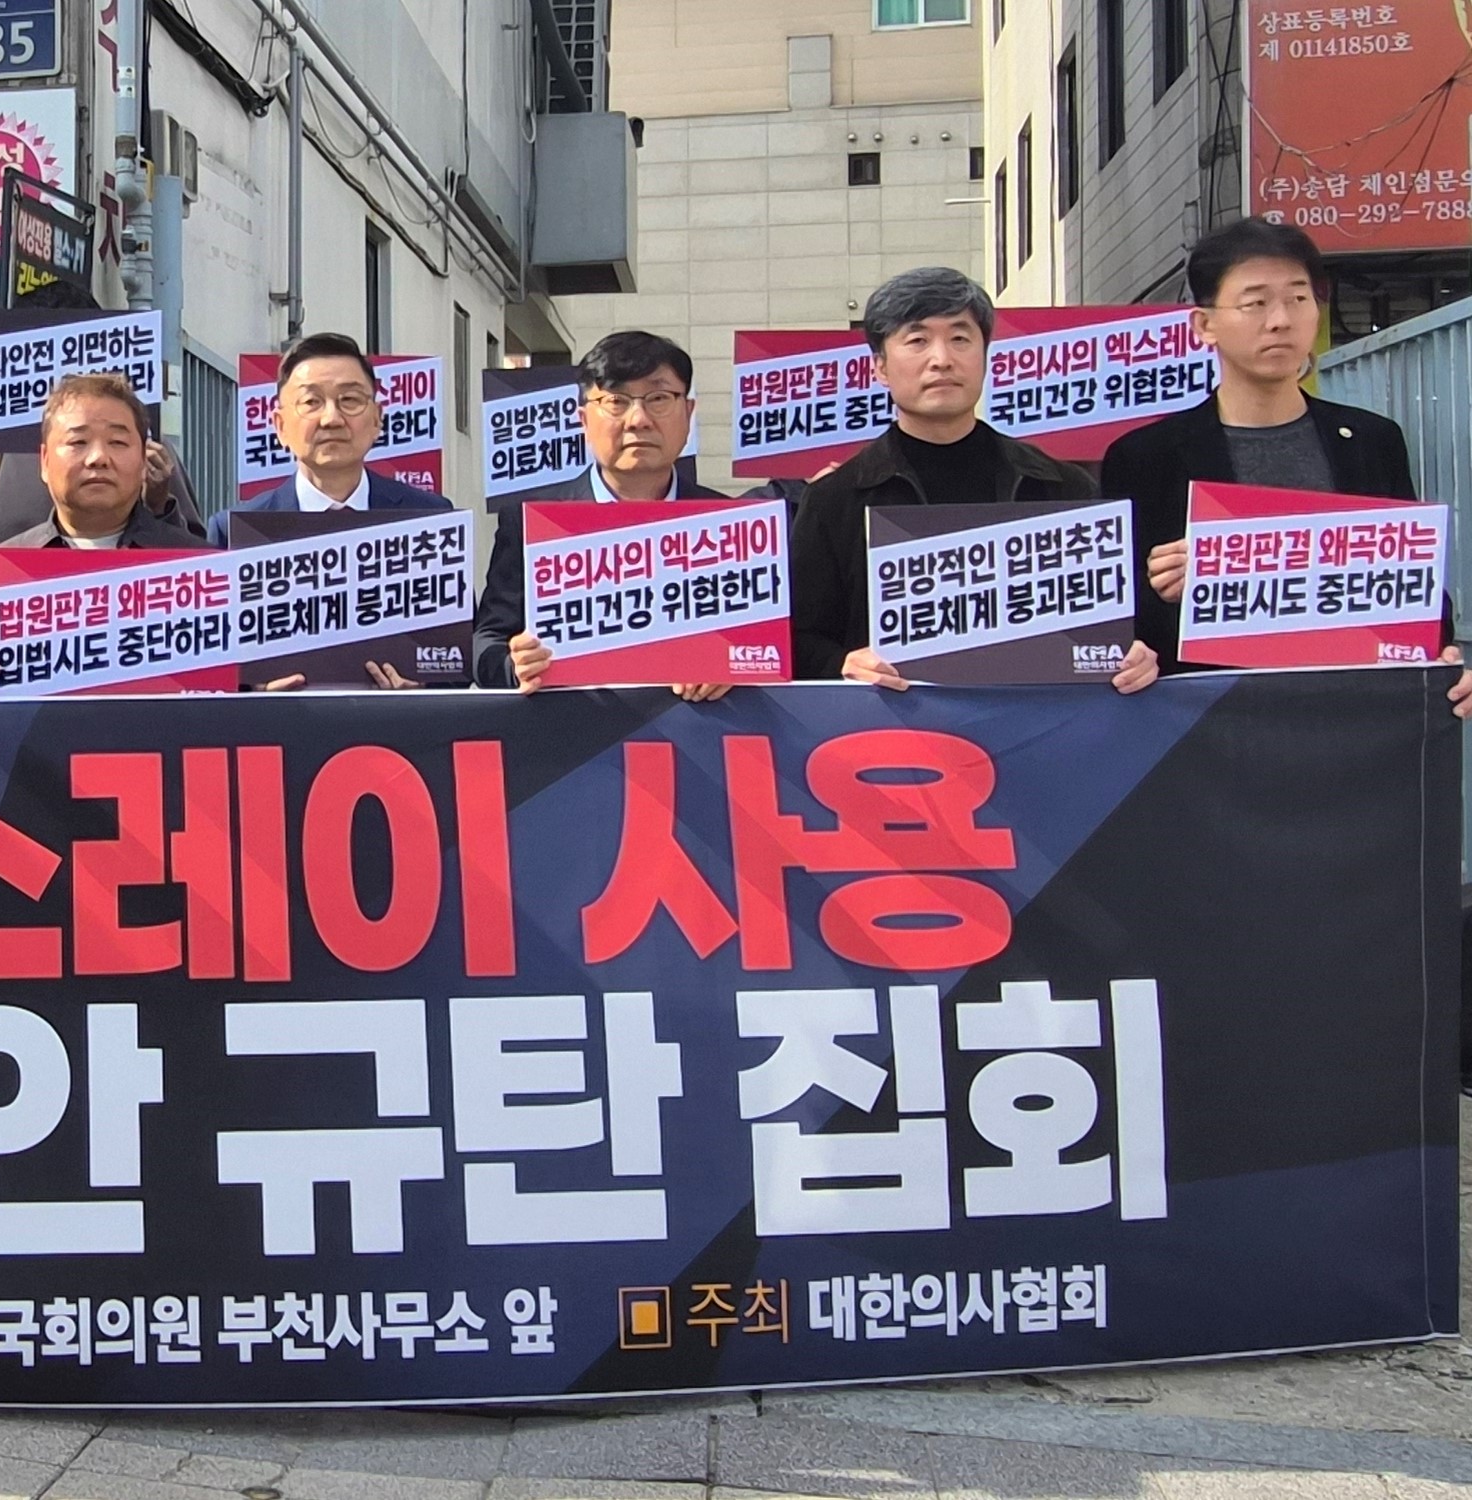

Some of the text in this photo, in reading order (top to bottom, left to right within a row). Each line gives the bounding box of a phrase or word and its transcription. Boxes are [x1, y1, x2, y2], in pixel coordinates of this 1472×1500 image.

[1258, 5, 1398, 35] 상표등록번호
[1258, 32, 1414, 62] 제 01141850호
[1259, 173, 1351, 202] (주)송담
[60, 325, 155, 368] 외면하는
[991, 336, 1097, 388] 한의사의
[739, 360, 839, 409] 법원판결
[991, 358, 1215, 427] 국민건강 위협한다
[490, 397, 584, 445] 일방적인
[739, 400, 838, 448] 입법시도
[490, 432, 586, 481] 의료체계
[238, 523, 466, 599] 일방적인 입법추진
[534, 515, 778, 598] 한의사의 엑스레이
[878, 516, 1124, 603] 일방적인 입법추진
[1194, 518, 1439, 577] 법원판결 왜곡하는
[116, 569, 230, 620] 왜곡하는
[238, 569, 467, 645] 의료체계 붕괴된다
[535, 563, 781, 644] 국민건강 위협한다
[878, 565, 1127, 647] 의료체계 붕괴된다
[1191, 566, 1436, 625] 입법시도 중단하라
[117, 611, 231, 667] 중단하라
[416, 646, 463, 660] KMA
[729, 645, 781, 660] KMA
[1073, 644, 1124, 660] KMA
[1378, 642, 1428, 662] KMA
[580, 728, 1017, 972] 사용
[216, 990, 683, 1258] 규탄
[735, 977, 1169, 1238] 집회
[217, 1288, 489, 1364] 부천사무소
[503, 1285, 559, 1356] 앞
[686, 1263, 1108, 1348] 주최 대한의사협회
